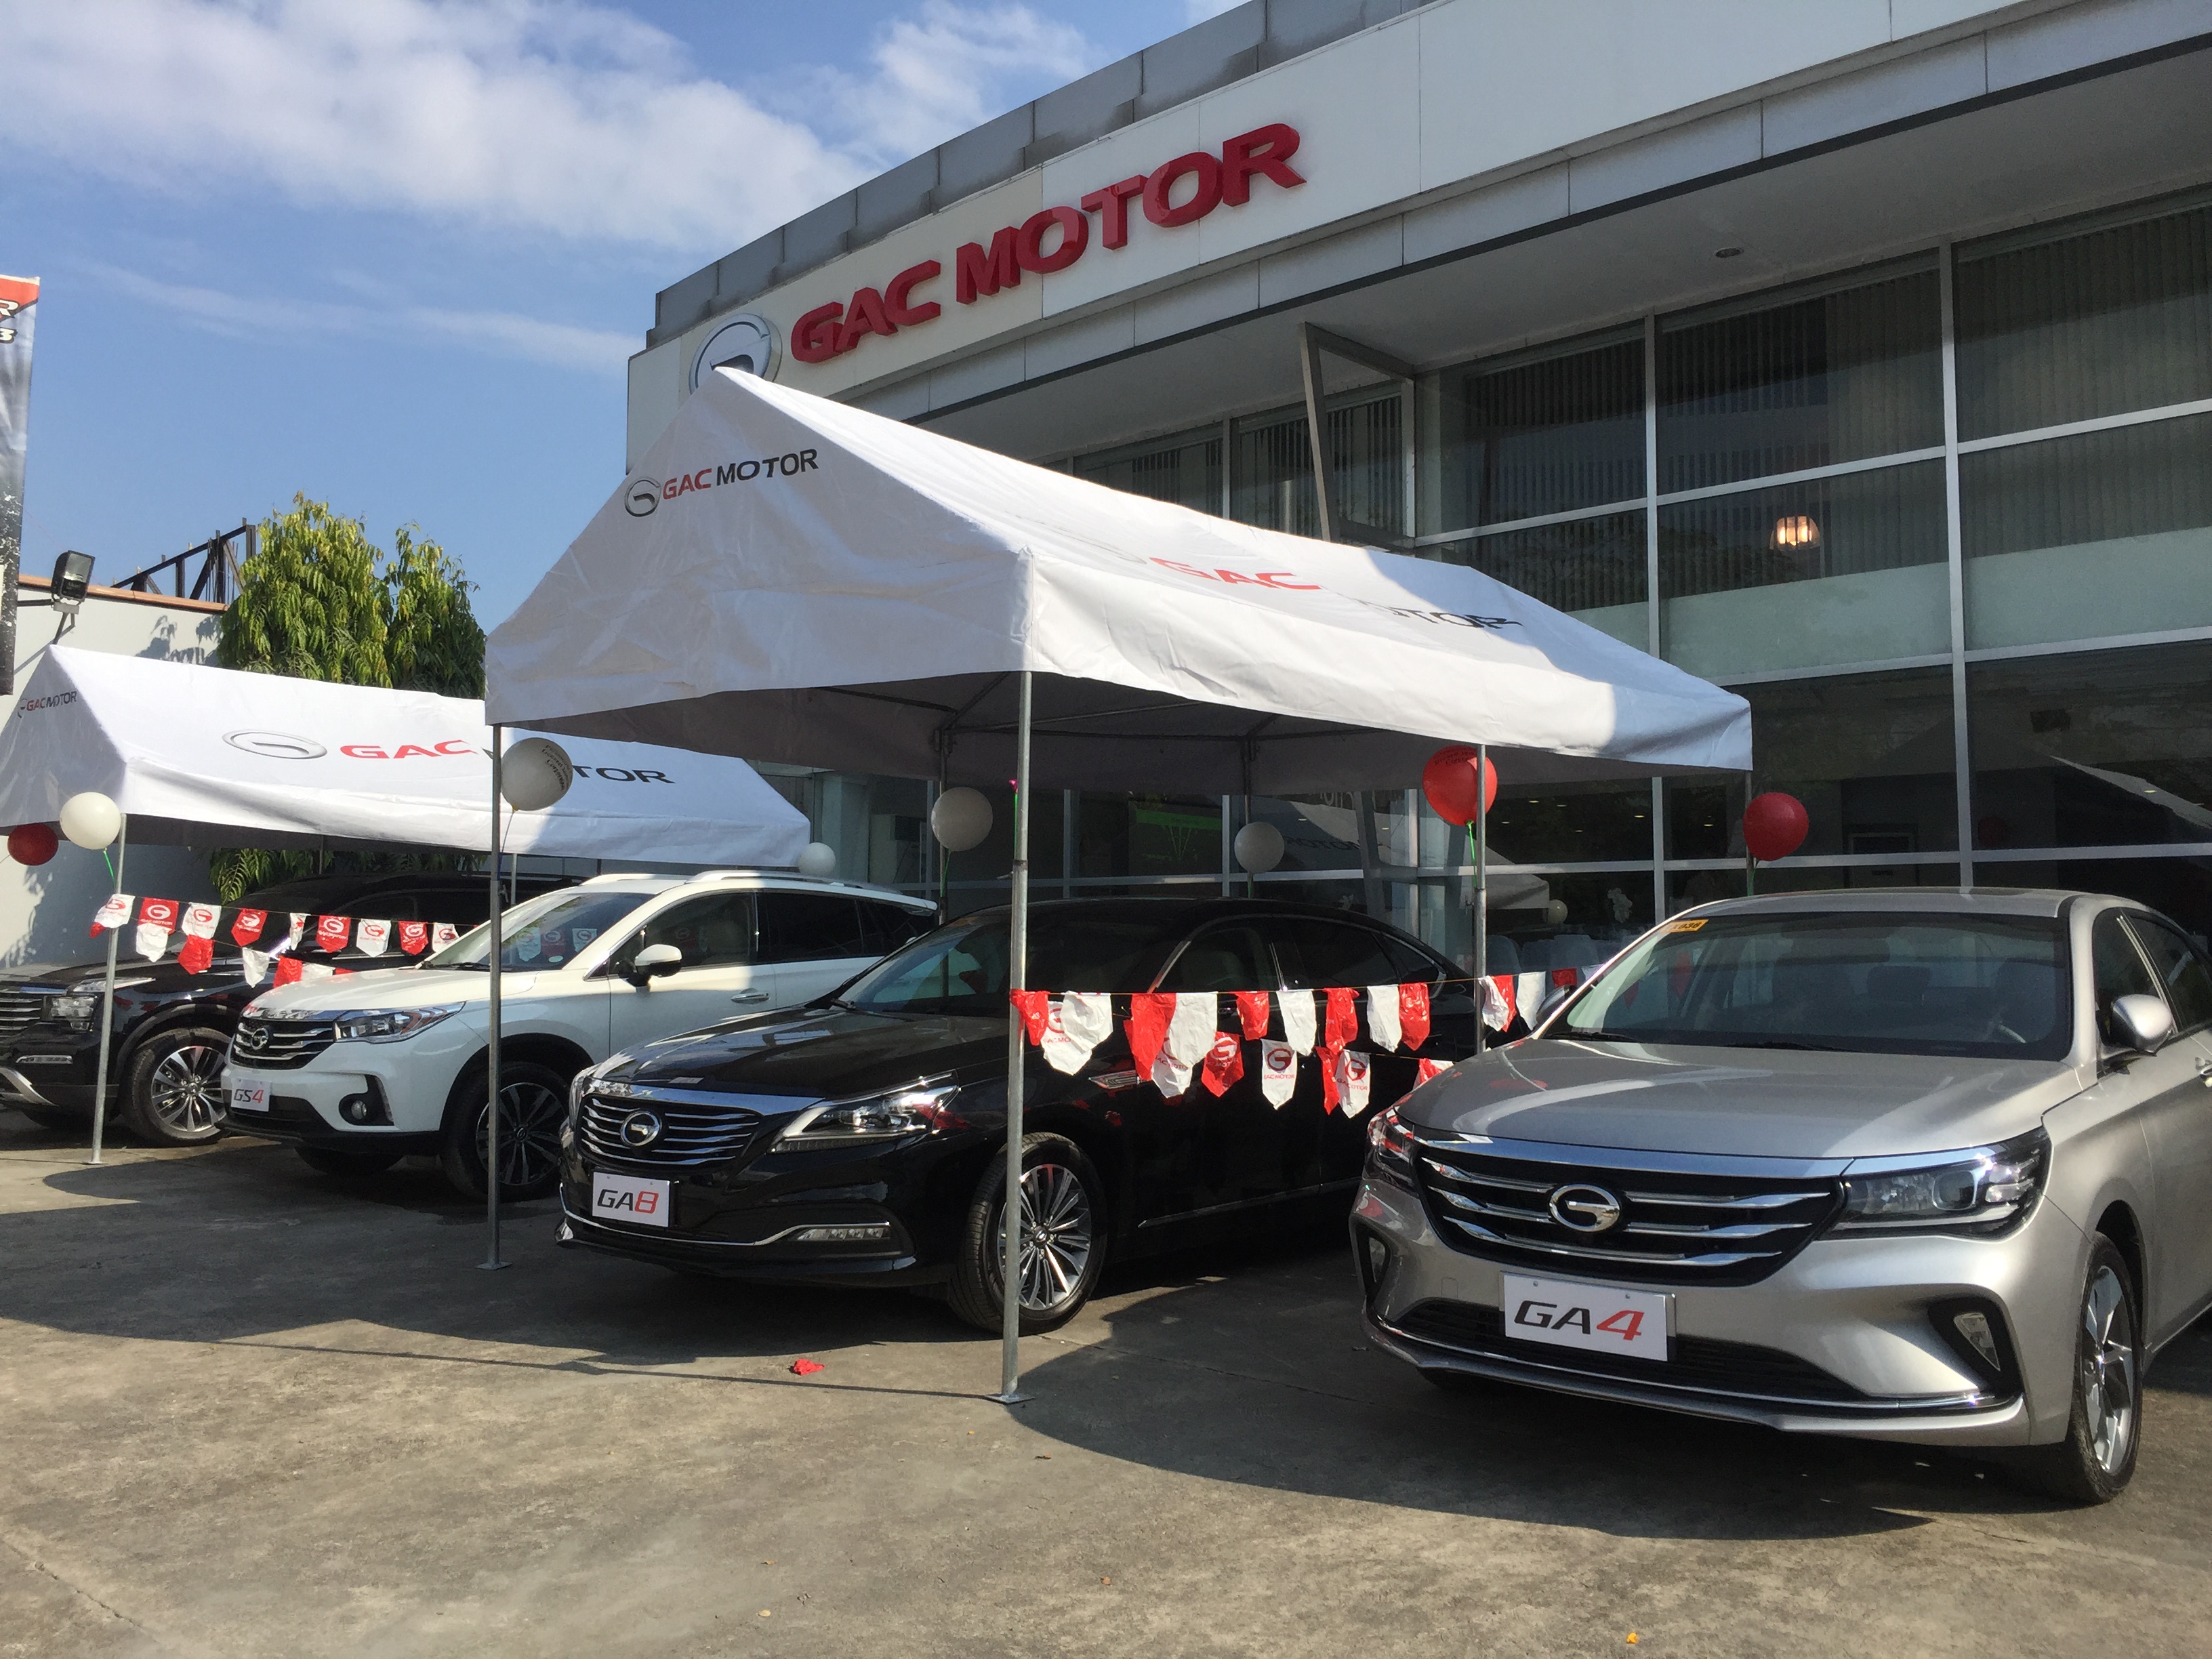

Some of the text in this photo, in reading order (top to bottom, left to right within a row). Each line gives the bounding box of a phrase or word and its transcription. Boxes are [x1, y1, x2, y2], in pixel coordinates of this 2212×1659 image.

[791, 123, 1307, 363] GAC MOTOR
[663, 449, 819, 499] GAC MOTOR
[1149, 557, 1321, 590] GAC
[340, 739, 478, 760] GAC
[234, 1088, 264, 1104] GS4
[597, 1189, 659, 1214] GA8
[1514, 1300, 1645, 1341] GA4
